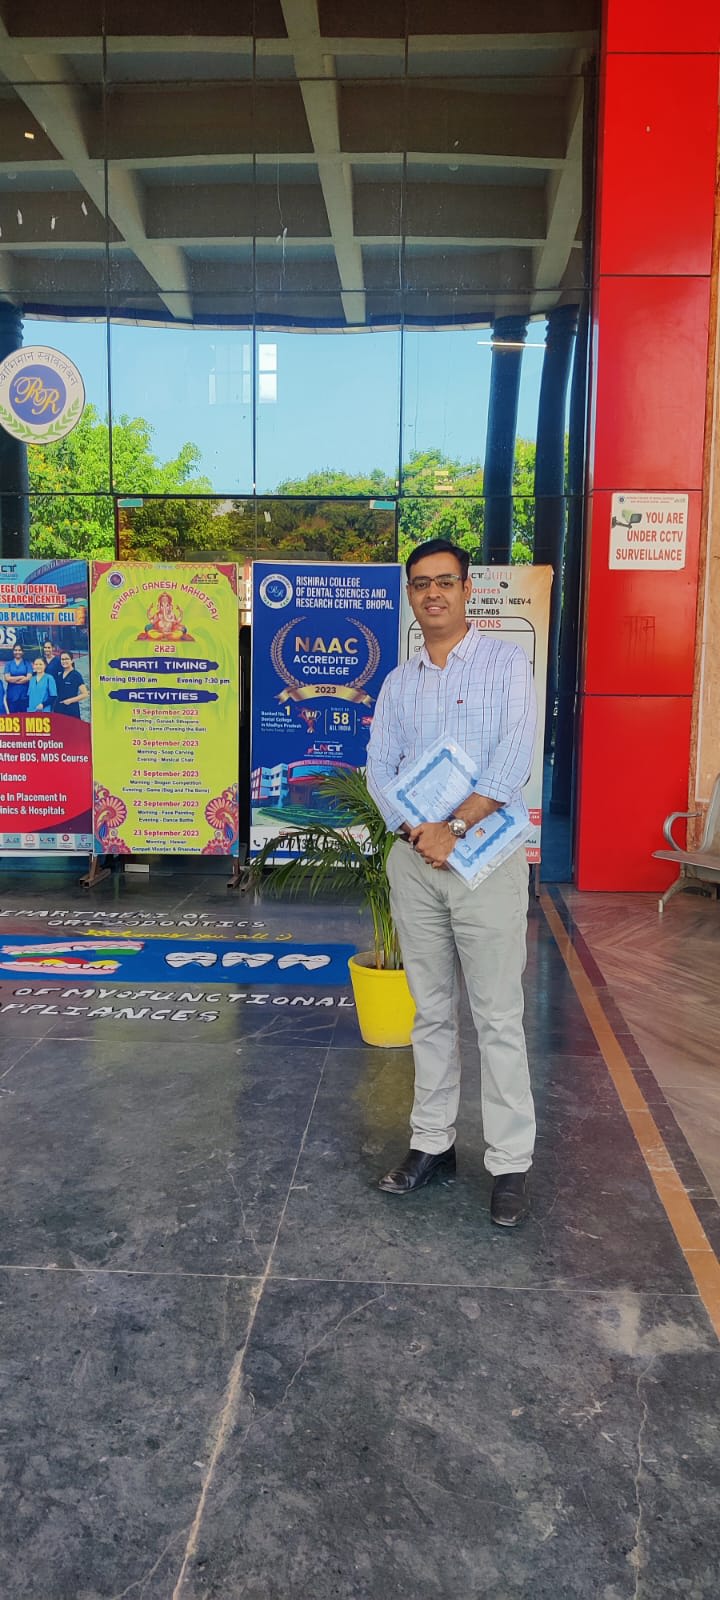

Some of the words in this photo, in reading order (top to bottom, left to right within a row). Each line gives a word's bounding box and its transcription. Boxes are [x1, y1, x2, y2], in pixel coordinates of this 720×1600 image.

[646, 512, 664, 523] YOU
[667, 512, 684, 524] ARE
[627, 530, 657, 542] UNDER
[660, 531, 683, 542] CCTV
[616, 548, 682, 560] SURVEILLANCE
[296, 576, 328, 586] RISHIRAJ
[330, 577, 360, 587] COLLEGE
[17, 585, 27, 593] OF
[29, 585, 58, 593] DENTAL
[296, 588, 304, 597] OF
[306, 588, 333, 597] DENTAL
[335, 589, 369, 598] SCIENCES
[371, 589, 386, 598] AND
[36, 595, 66, 603] CENTRE
[111, 586, 139, 619] RISHIRAJ
[142, 581, 177, 590] GANESH
[181, 584, 219, 620] MAHOTSAV
[296, 598, 332, 608] RESEARCH
[366, 600, 394, 610] BHOPAL
[11, 612, 54, 621] PLACEMENT
[59, 612, 74, 621] CELL
[295, 637, 358, 653] NAAC
[293, 655, 358, 665] ACCREDITED
[120, 661, 158, 669] AARTI
[164, 662, 207, 670] TIMING
[303, 666, 349, 675] COLLEGE
[177, 677, 202, 685] Evening
[128, 692, 198, 700] ACTIVITIES
[333, 712, 349, 724] 58
[0, 717, 20, 732] BDS
[25, 718, 50, 732] MDS
[38, 740, 63, 751] Option
[41, 754, 59, 762] MDS
[61, 754, 88, 762] Course
[7, 793, 14, 801] In
[16, 793, 57, 801] Placement
[60, 794, 66, 802] In
[20, 806, 26, 814] &
[29, 806, 65, 816] Hospitals
[14, 988, 62, 996] OF
[61, 988, 355, 1007] MYOFUNCTIONAL
